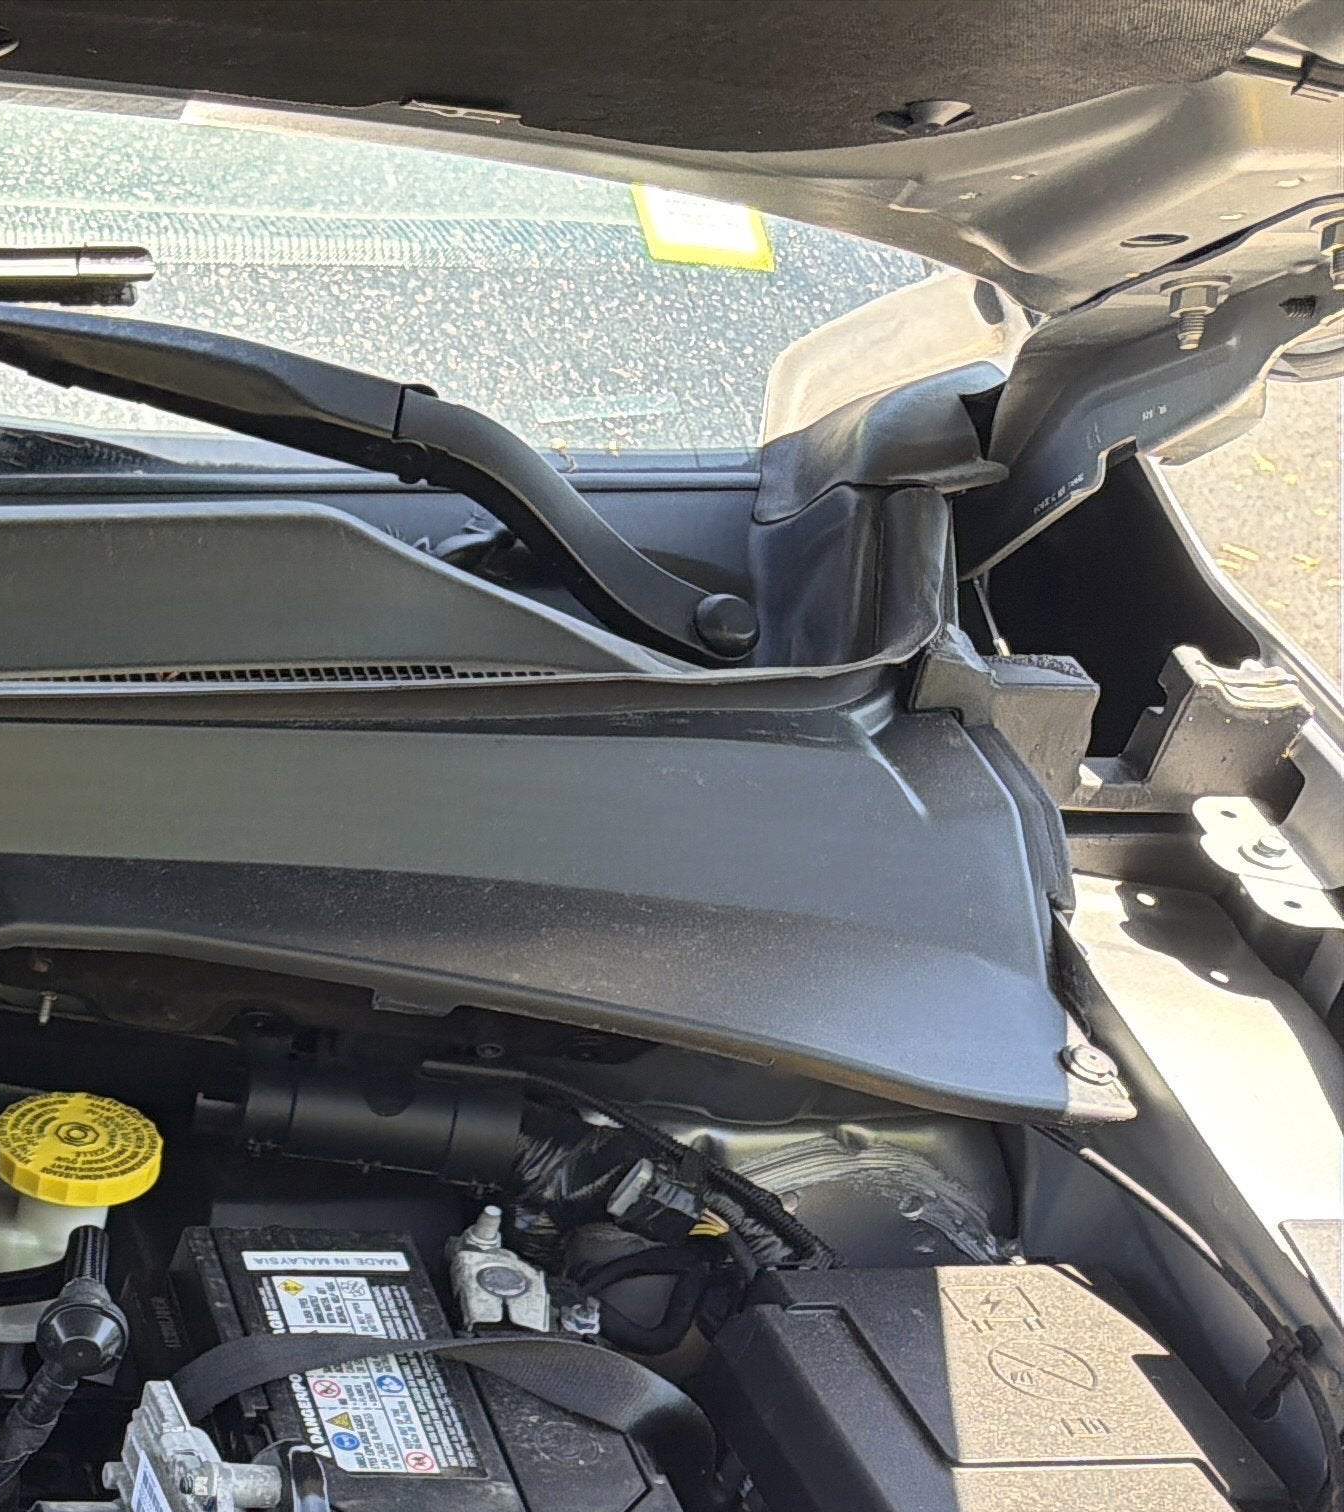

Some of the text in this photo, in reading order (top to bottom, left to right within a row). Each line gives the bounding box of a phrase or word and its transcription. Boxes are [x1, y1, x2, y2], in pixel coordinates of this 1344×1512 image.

[253, 1256, 398, 1267] MADE IN MALAYSIA
